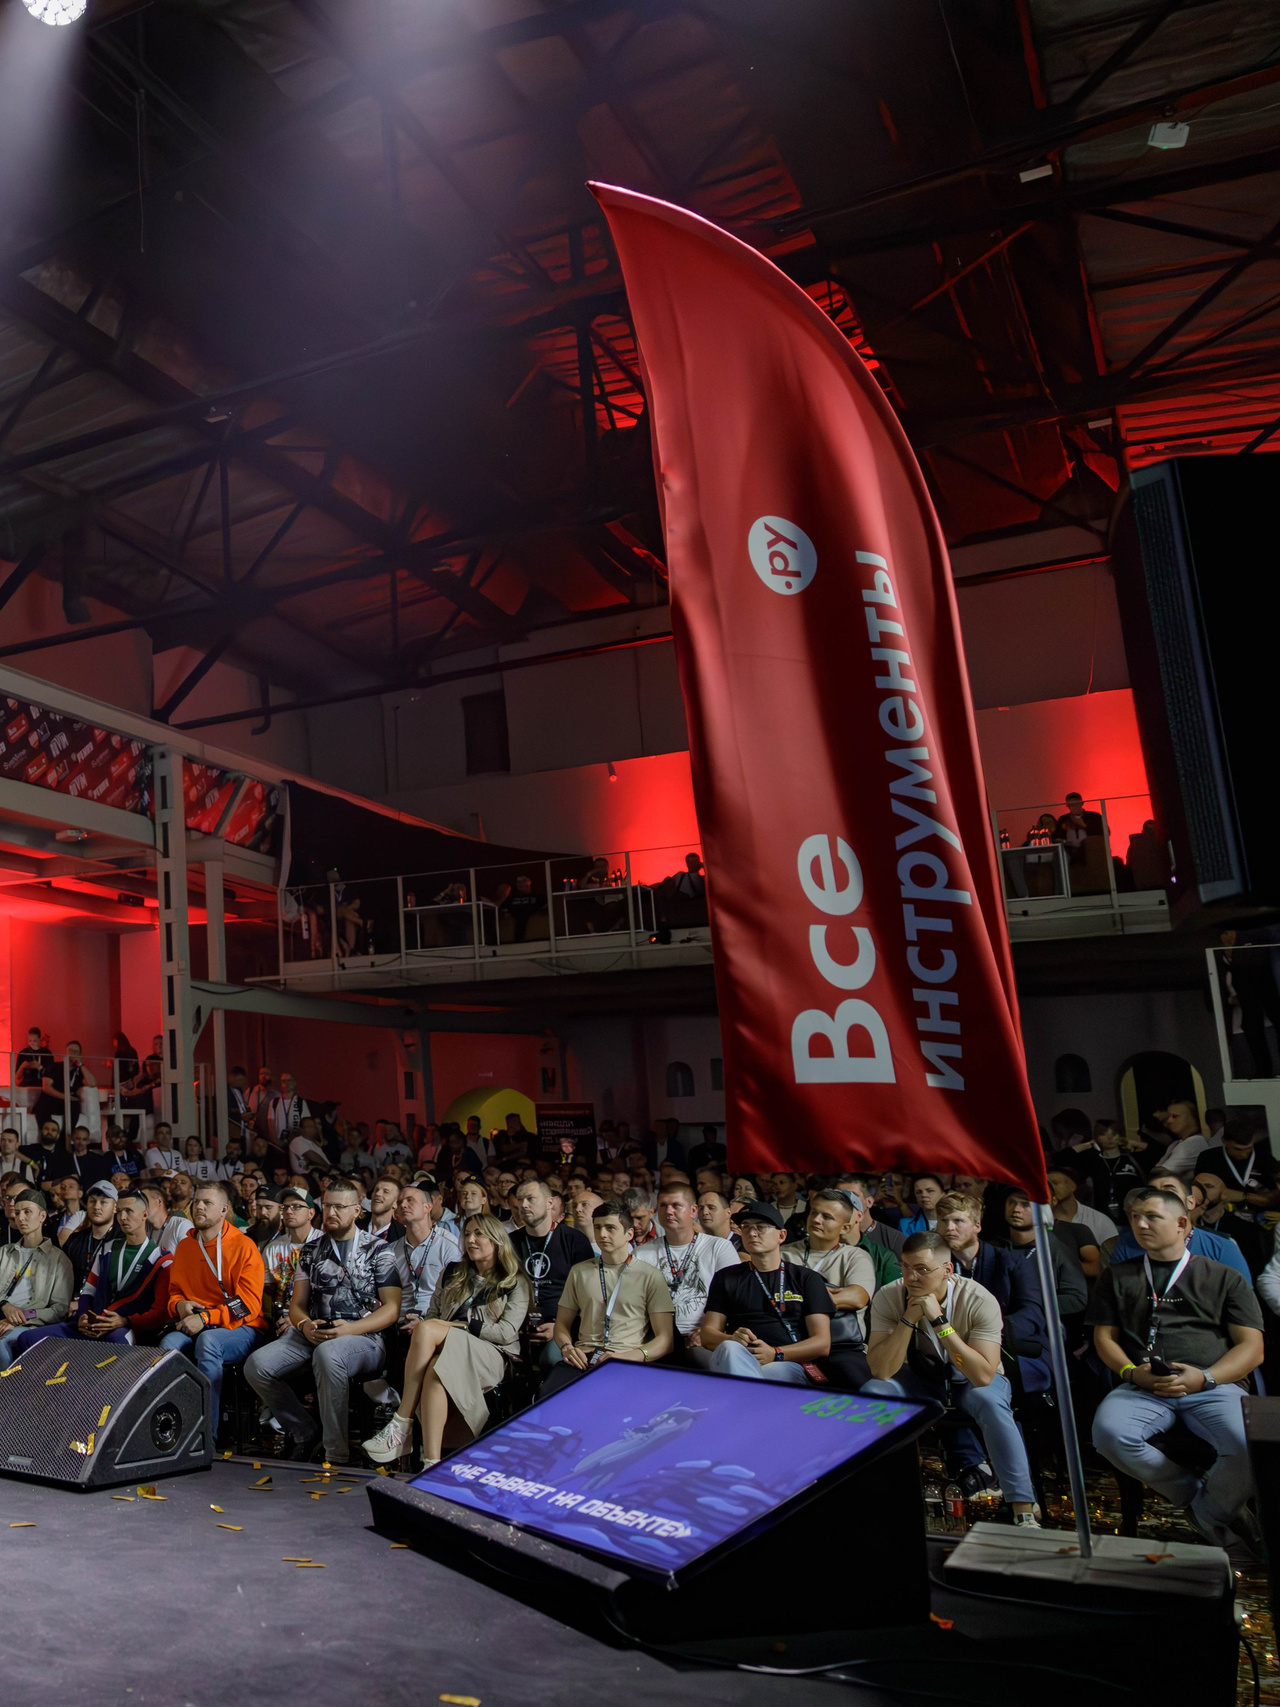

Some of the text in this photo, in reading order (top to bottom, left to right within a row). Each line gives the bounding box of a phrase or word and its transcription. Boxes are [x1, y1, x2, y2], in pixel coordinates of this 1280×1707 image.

[854, 550, 973, 1091] инструменты
[791, 833, 898, 1084] Все
[478, 1471, 557, 1500] БЫВАЕТ
[547, 1491, 587, 1509] НА
